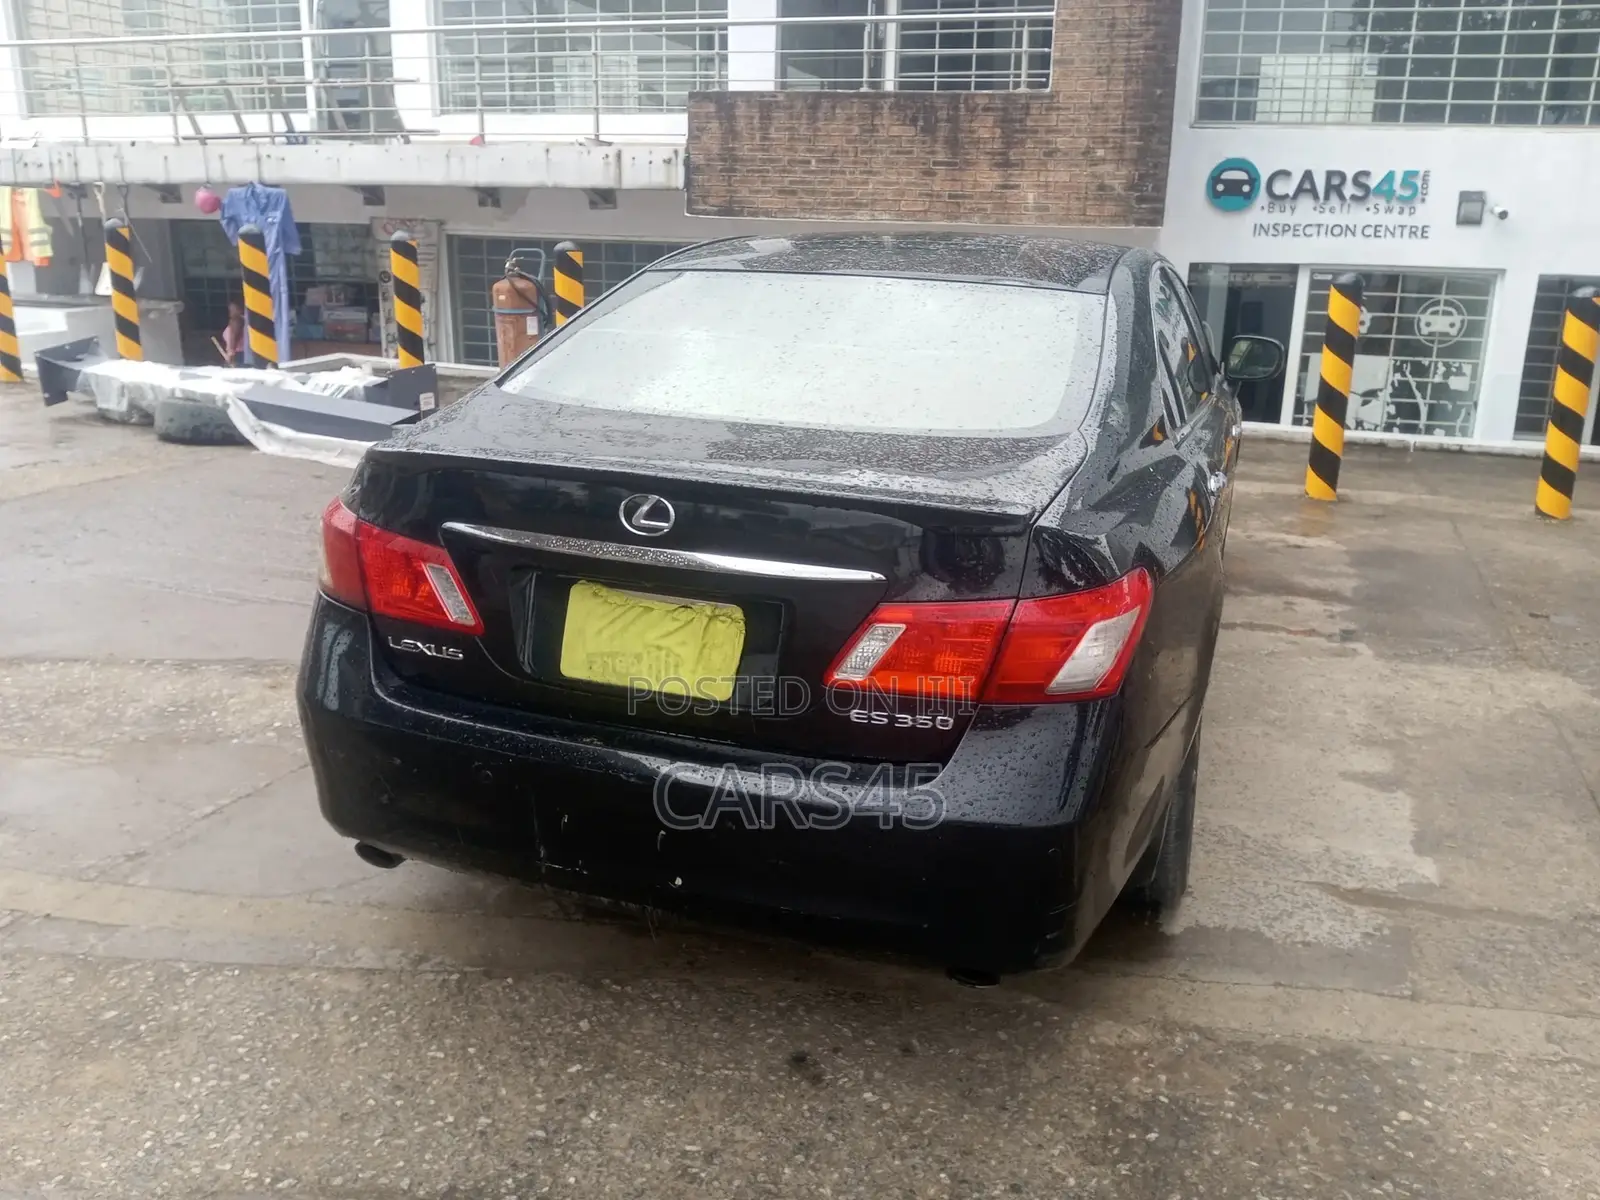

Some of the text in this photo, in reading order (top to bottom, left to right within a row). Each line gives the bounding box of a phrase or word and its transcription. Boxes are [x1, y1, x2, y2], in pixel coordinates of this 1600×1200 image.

[1265, 169, 1420, 202] CARS45
[1253, 222, 1431, 240] INSPECTION CENTRE
[387, 635, 464, 661] LEXUS
[850, 709, 954, 731] ES 350
